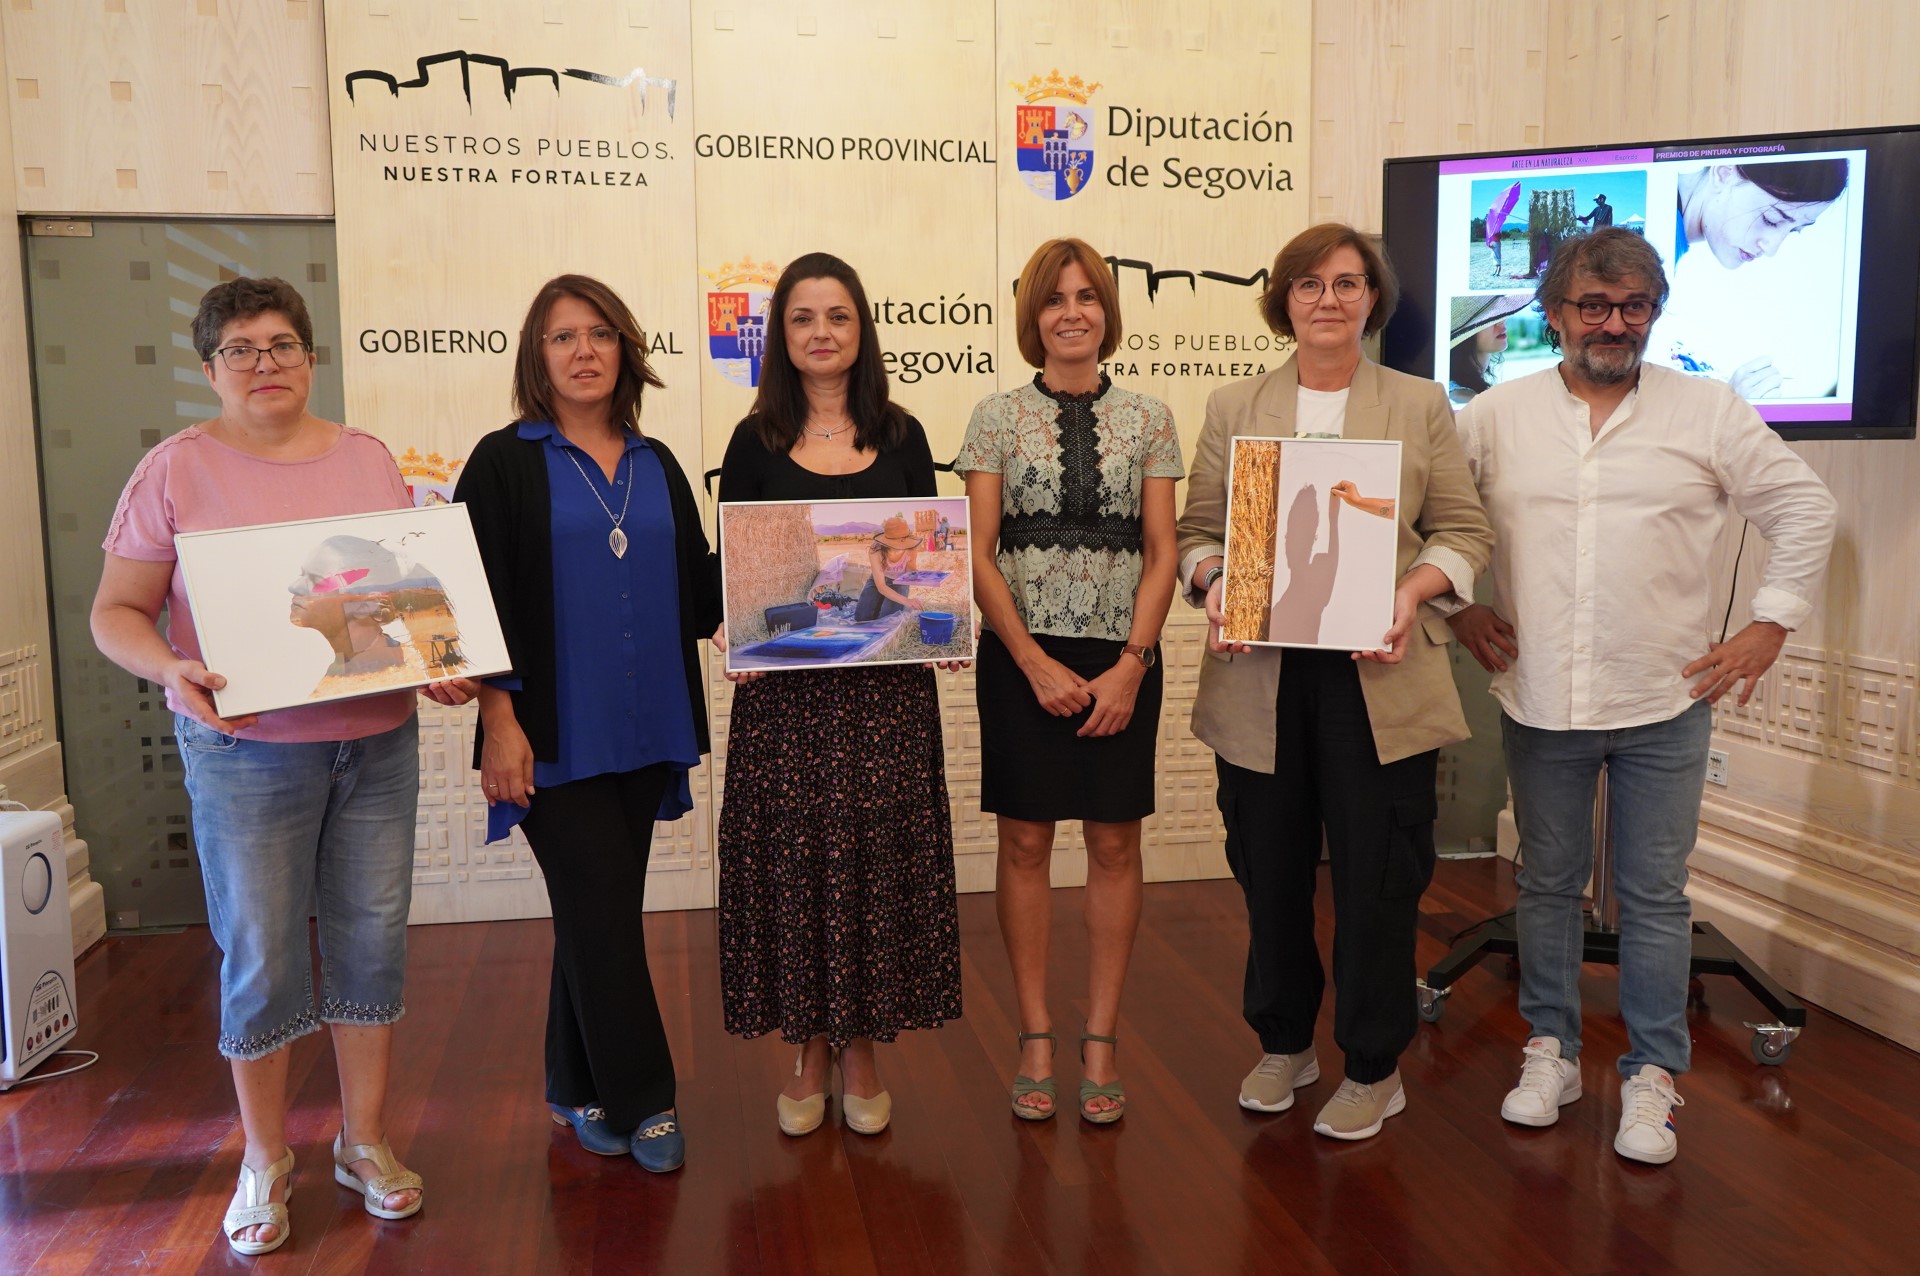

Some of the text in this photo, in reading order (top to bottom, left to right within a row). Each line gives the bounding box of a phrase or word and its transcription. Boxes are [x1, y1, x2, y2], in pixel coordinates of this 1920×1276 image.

[1108, 105, 1293, 146] Diputación
[360, 133, 674, 160] NUESTROS PUEBLOS,
[695, 133, 997, 163] GOBIERNO PROVINCIAL
[1655, 150, 1689, 159] PREMIOS
[1689, 149, 1700, 157] DE
[1700, 148, 1732, 156] PINTURA
[1739, 144, 1785, 154] FOTOGRAFÍA
[1511, 160, 1524, 169] ARTE
[1525, 160, 1533, 168] EN
[1533, 159, 1540, 167] LA
[1540, 157, 1573, 167] NATURALEZA
[383, 166, 649, 187] NUESTRA FORTALEZA
[1106, 156, 1294, 199] de Segovia
[359, 329, 508, 354] GOBIERNO
[882, 344, 995, 384] egovia
[1151, 363, 1267, 377] FORTALEZA
